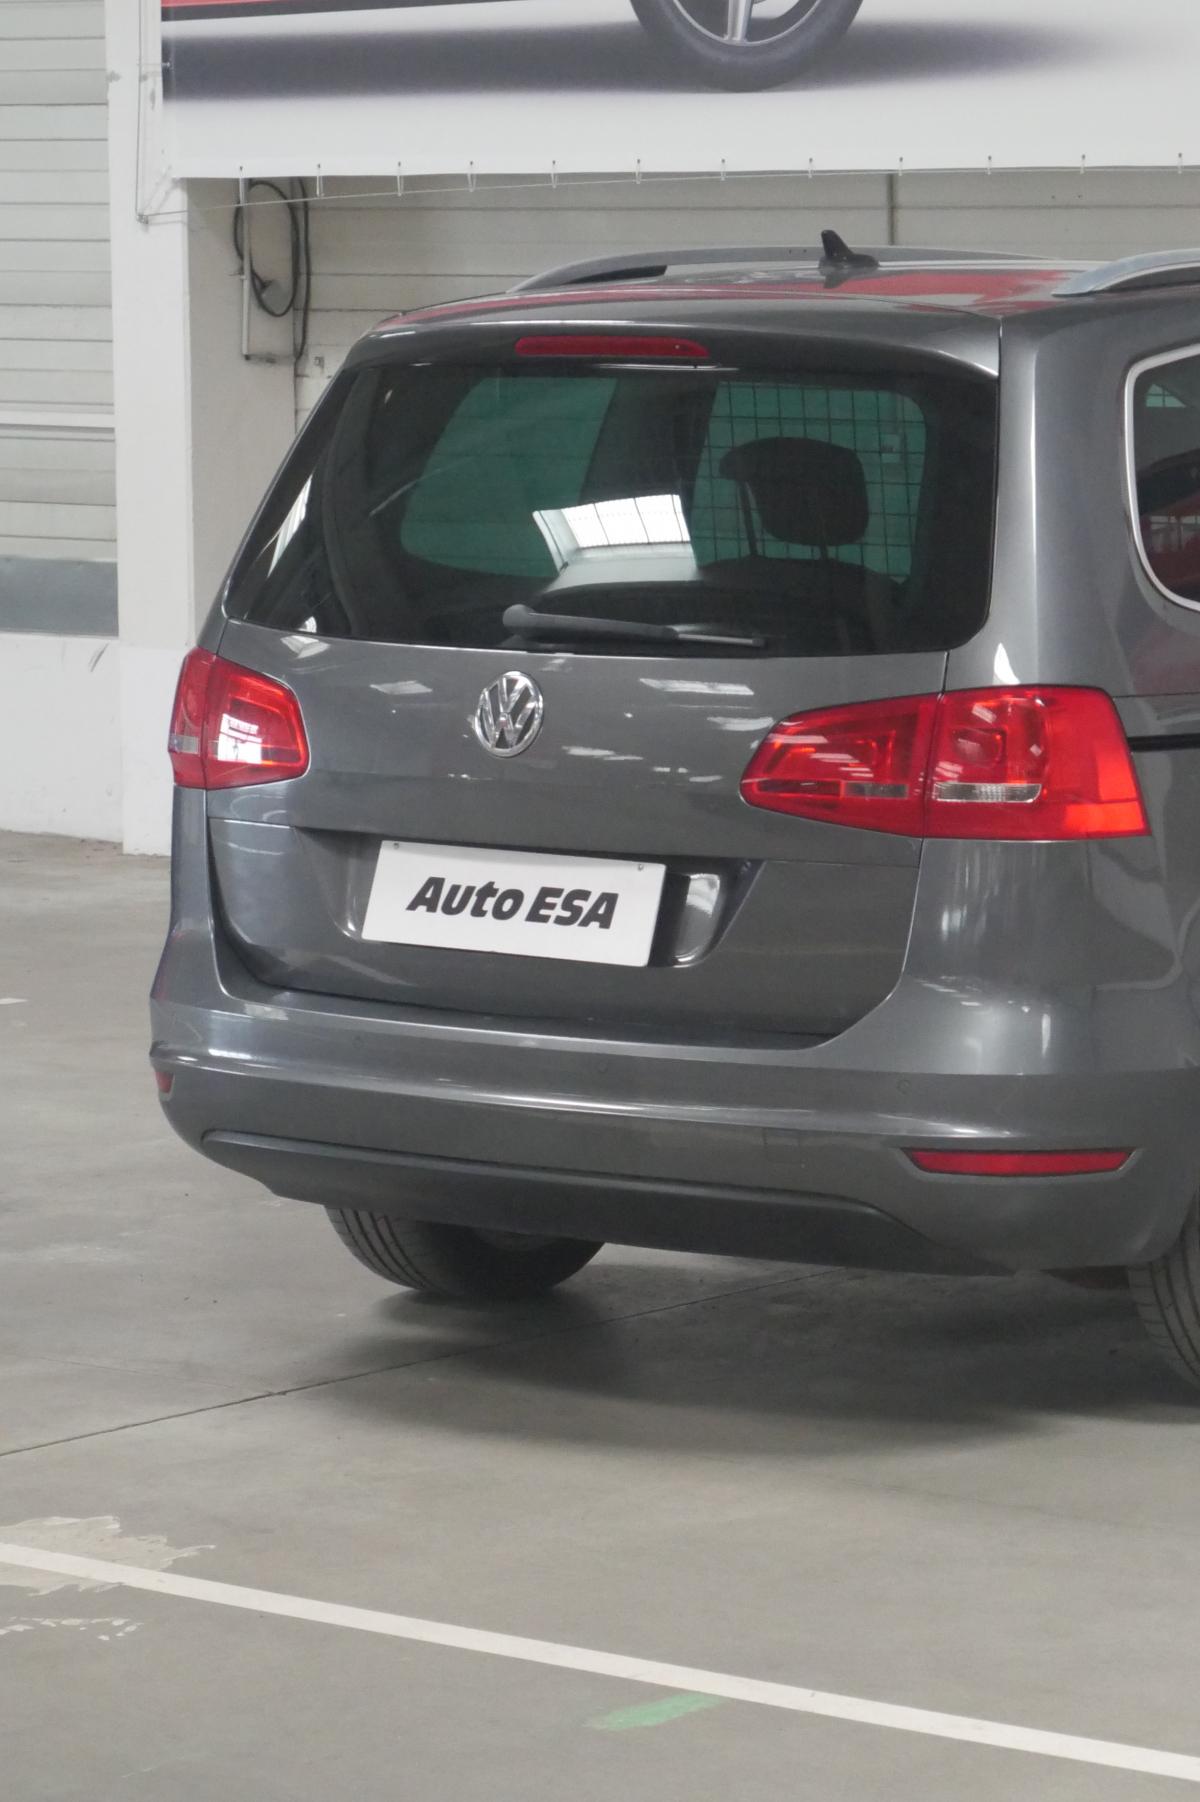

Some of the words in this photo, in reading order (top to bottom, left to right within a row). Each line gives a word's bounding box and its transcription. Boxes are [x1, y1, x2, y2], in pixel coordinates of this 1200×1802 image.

[475, 670, 543, 757] VW
[406, 876, 525, 920] Auto
[524, 886, 619, 930] ESA
